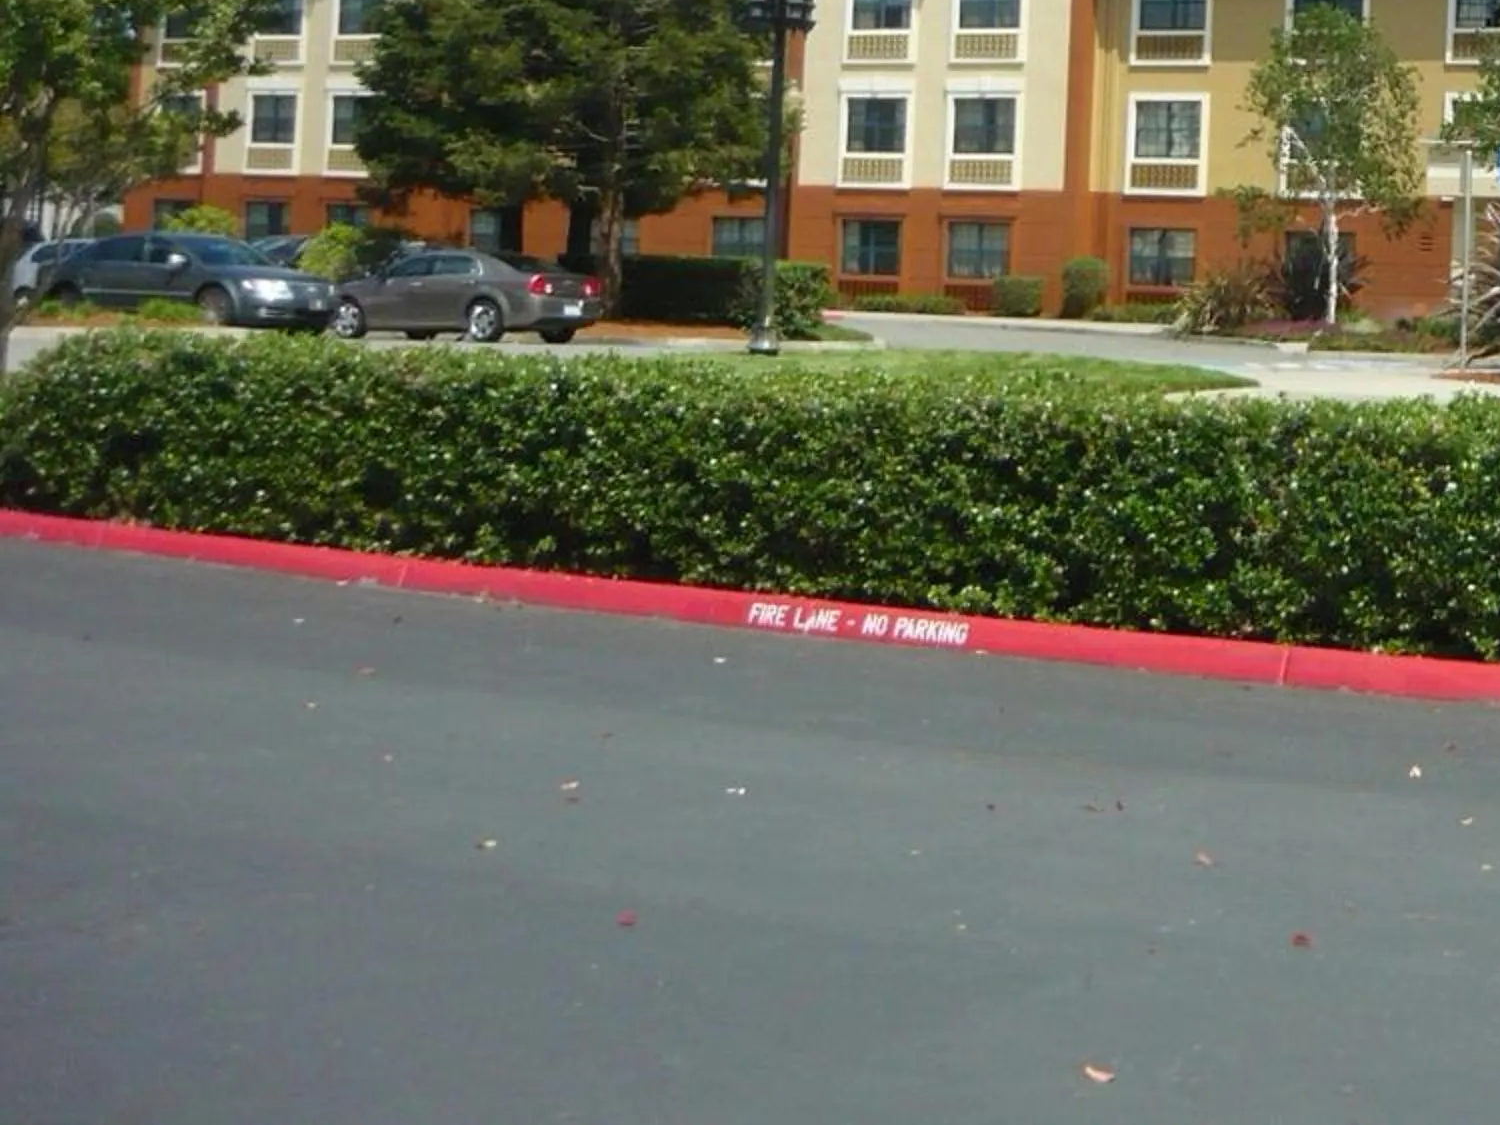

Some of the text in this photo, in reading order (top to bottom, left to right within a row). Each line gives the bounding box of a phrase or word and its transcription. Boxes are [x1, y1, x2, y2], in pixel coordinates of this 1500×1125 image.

[748, 603, 789, 625] FIRE
[793, 607, 841, 633] LANE
[861, 613, 889, 635] NO
[892, 617, 969, 644] PARKING
